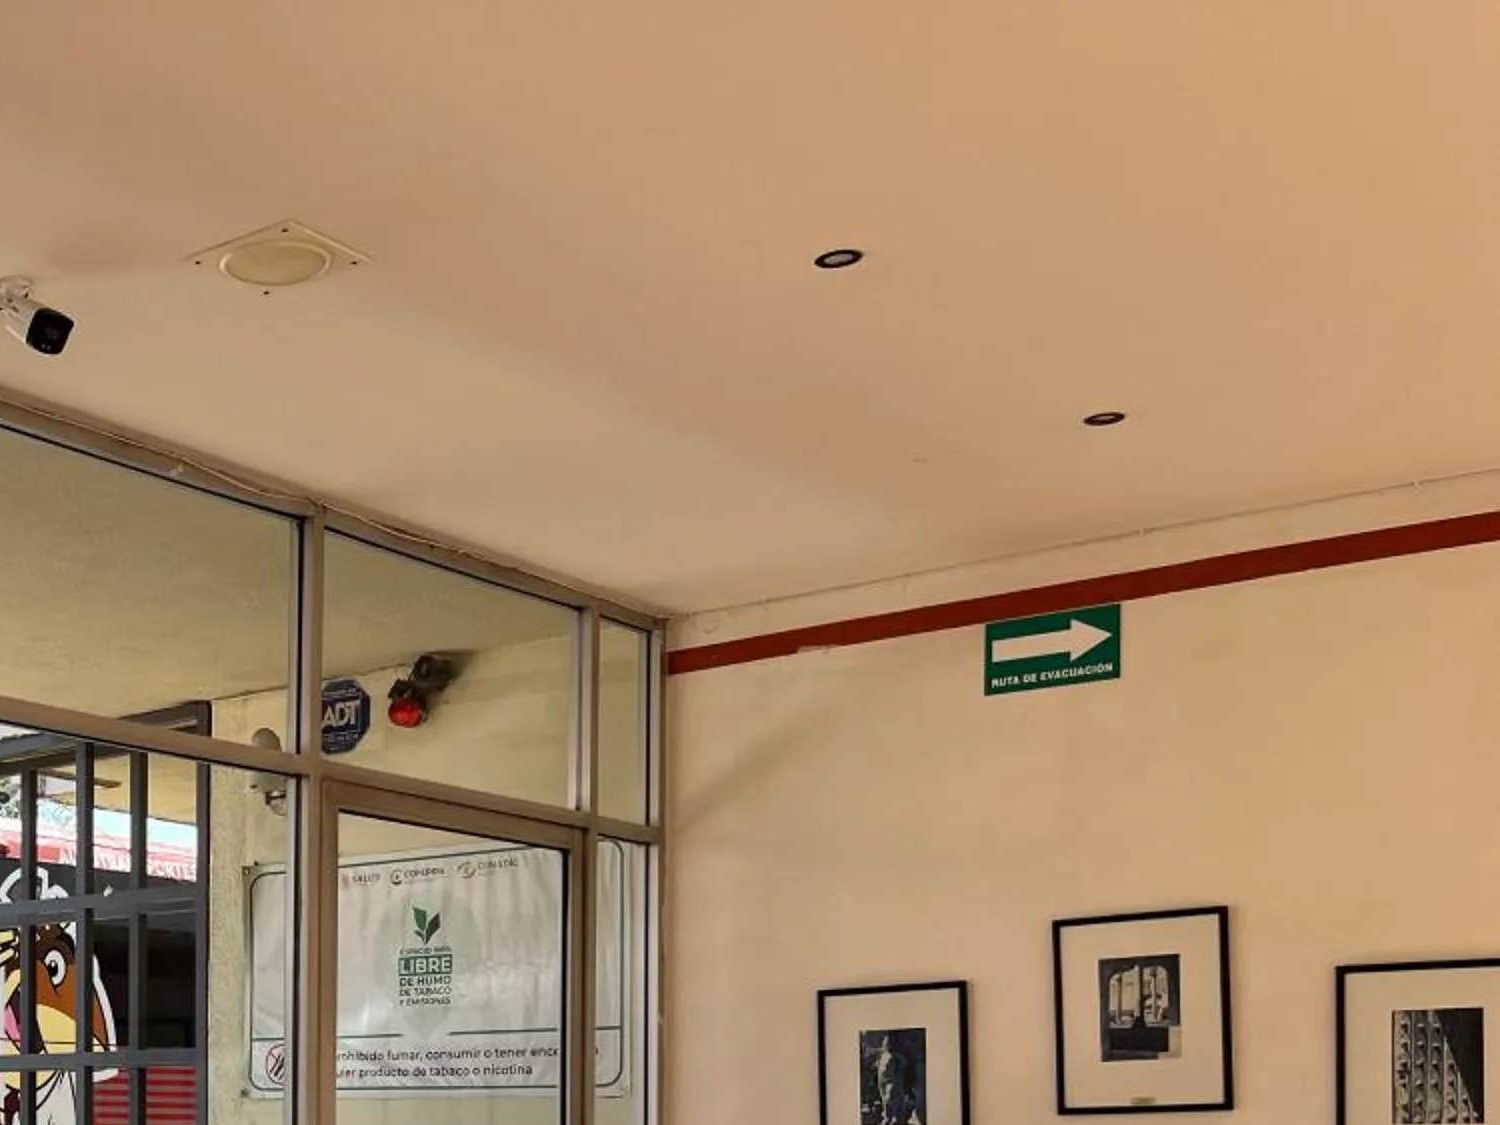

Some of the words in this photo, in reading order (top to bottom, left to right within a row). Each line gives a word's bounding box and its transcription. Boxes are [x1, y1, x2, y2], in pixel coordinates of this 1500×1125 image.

[991, 676, 1020, 688] RUTA
[1023, 672, 1037, 683] DE
[322, 700, 361, 726] ADT
[400, 957, 451, 974] LIBRE
[400, 977, 414, 987] DE
[417, 975, 452, 986] HUMO
[426, 1047, 480, 1060] consumir
[495, 1047, 527, 1058] tener
[359, 1065, 411, 1079] producto
[412, 1066, 428, 1077] de
[429, 1065, 471, 1076] tabaco
[483, 1063, 533, 1075] nicotina
